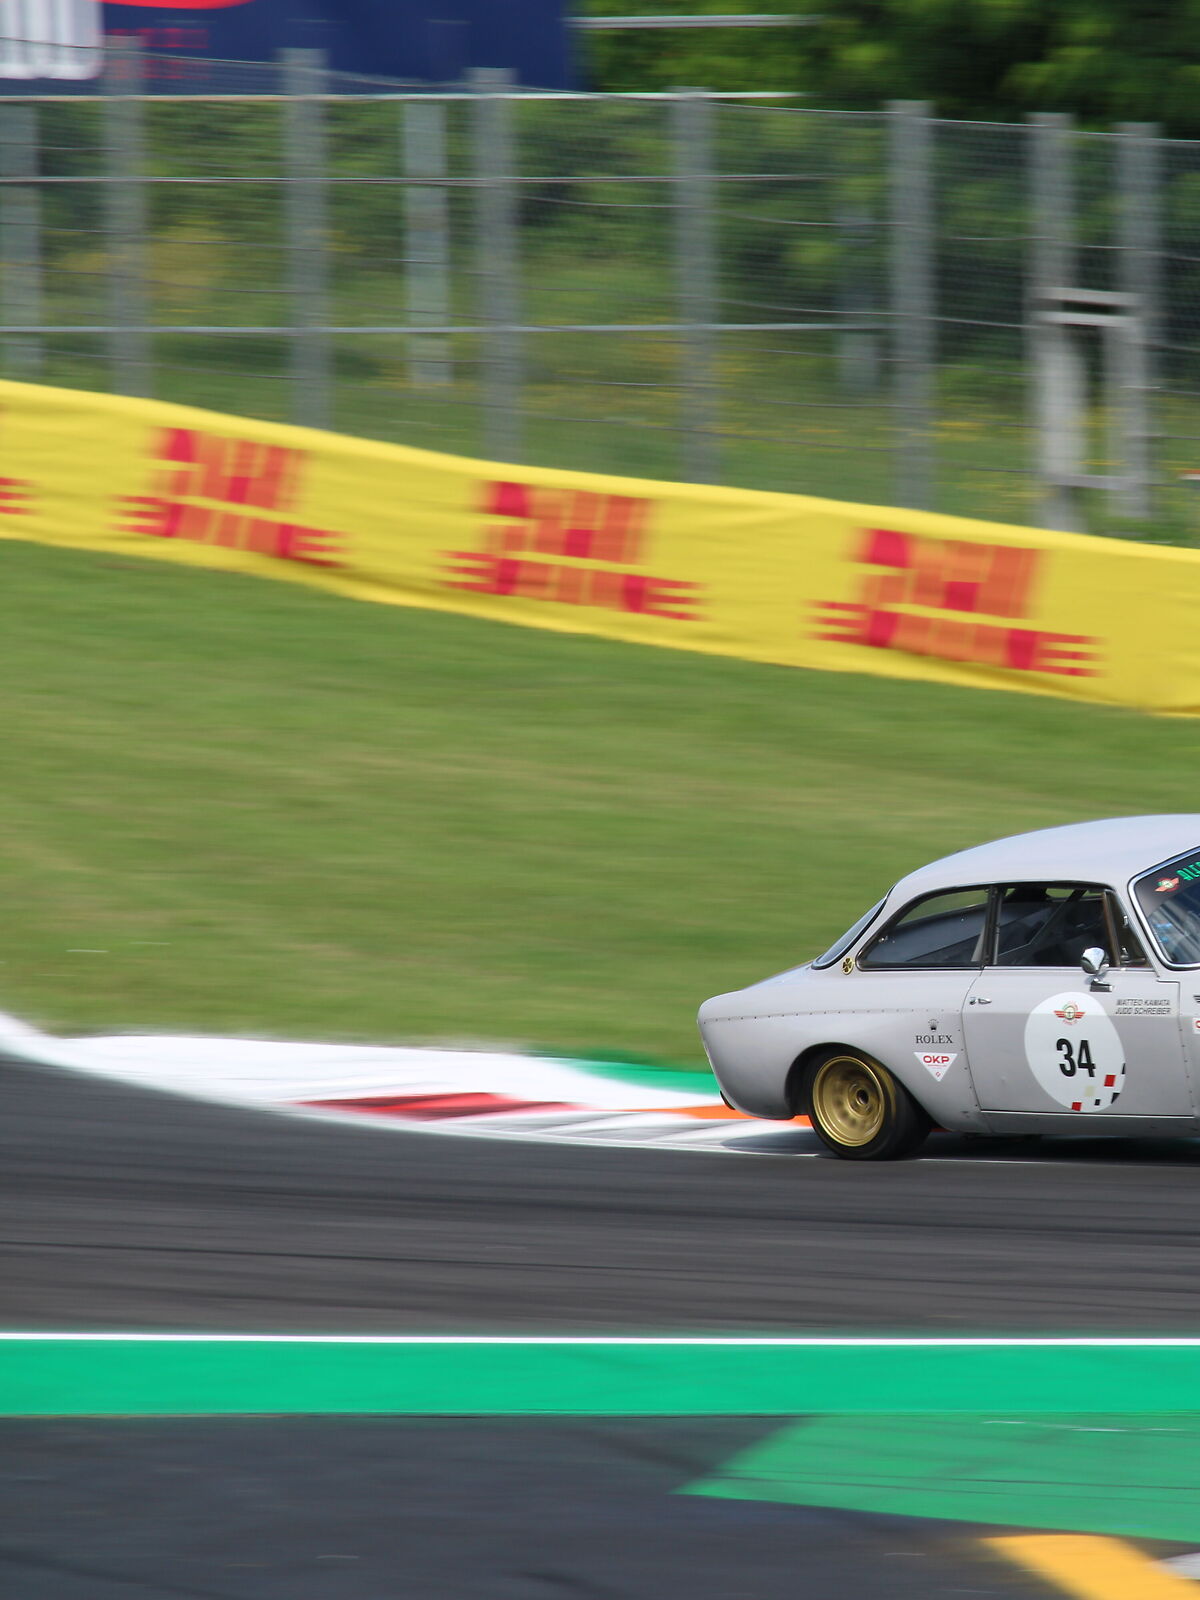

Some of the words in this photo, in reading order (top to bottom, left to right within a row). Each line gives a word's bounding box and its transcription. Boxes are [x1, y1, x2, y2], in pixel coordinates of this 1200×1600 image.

[915, 1034, 953, 1044] ROLEX
[923, 1055, 950, 1064] OKP
[1056, 1038, 1096, 1078] 34
